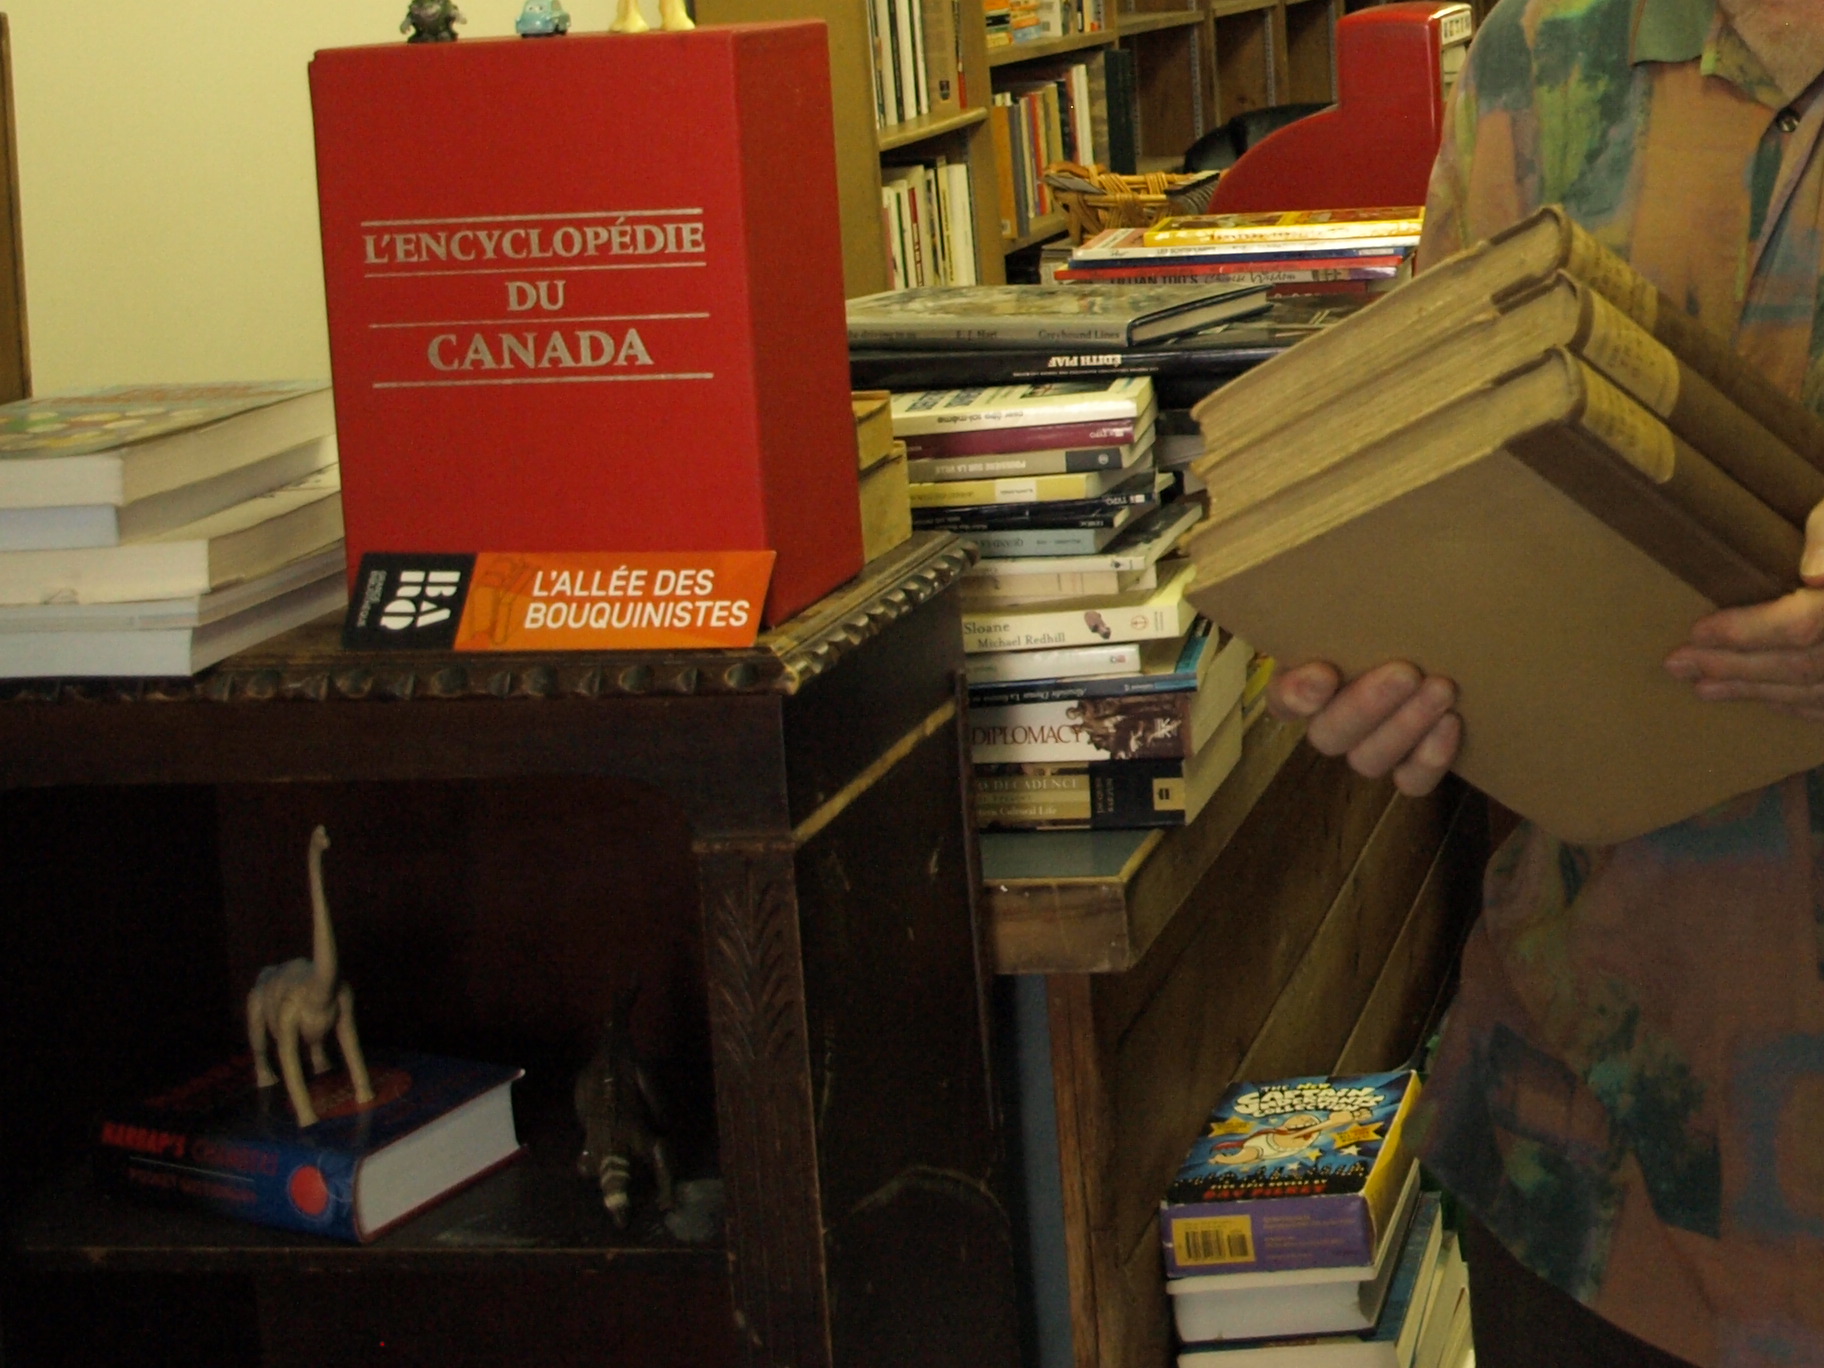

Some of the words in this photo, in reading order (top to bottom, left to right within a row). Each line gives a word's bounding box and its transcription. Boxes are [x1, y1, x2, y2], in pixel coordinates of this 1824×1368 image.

[363, 217, 705, 264] L'ENCYCLOPÉDIE
[506, 281, 566, 312] DU
[428, 328, 654, 372] CANADA
[1048, 356, 1078, 368] PIAF
[1080, 354, 1122, 368] ÉDITH
[532, 565, 649, 597] L'ALLÉE
[654, 569, 714, 597] DES
[524, 600, 750, 629] BOUQUINISTES
[964, 622, 1010, 636] Sloane
[978, 636, 1021, 649] Michael
[1026, 633, 1066, 646] Redhill
[971, 726, 1083, 746] DIPLOMACY
